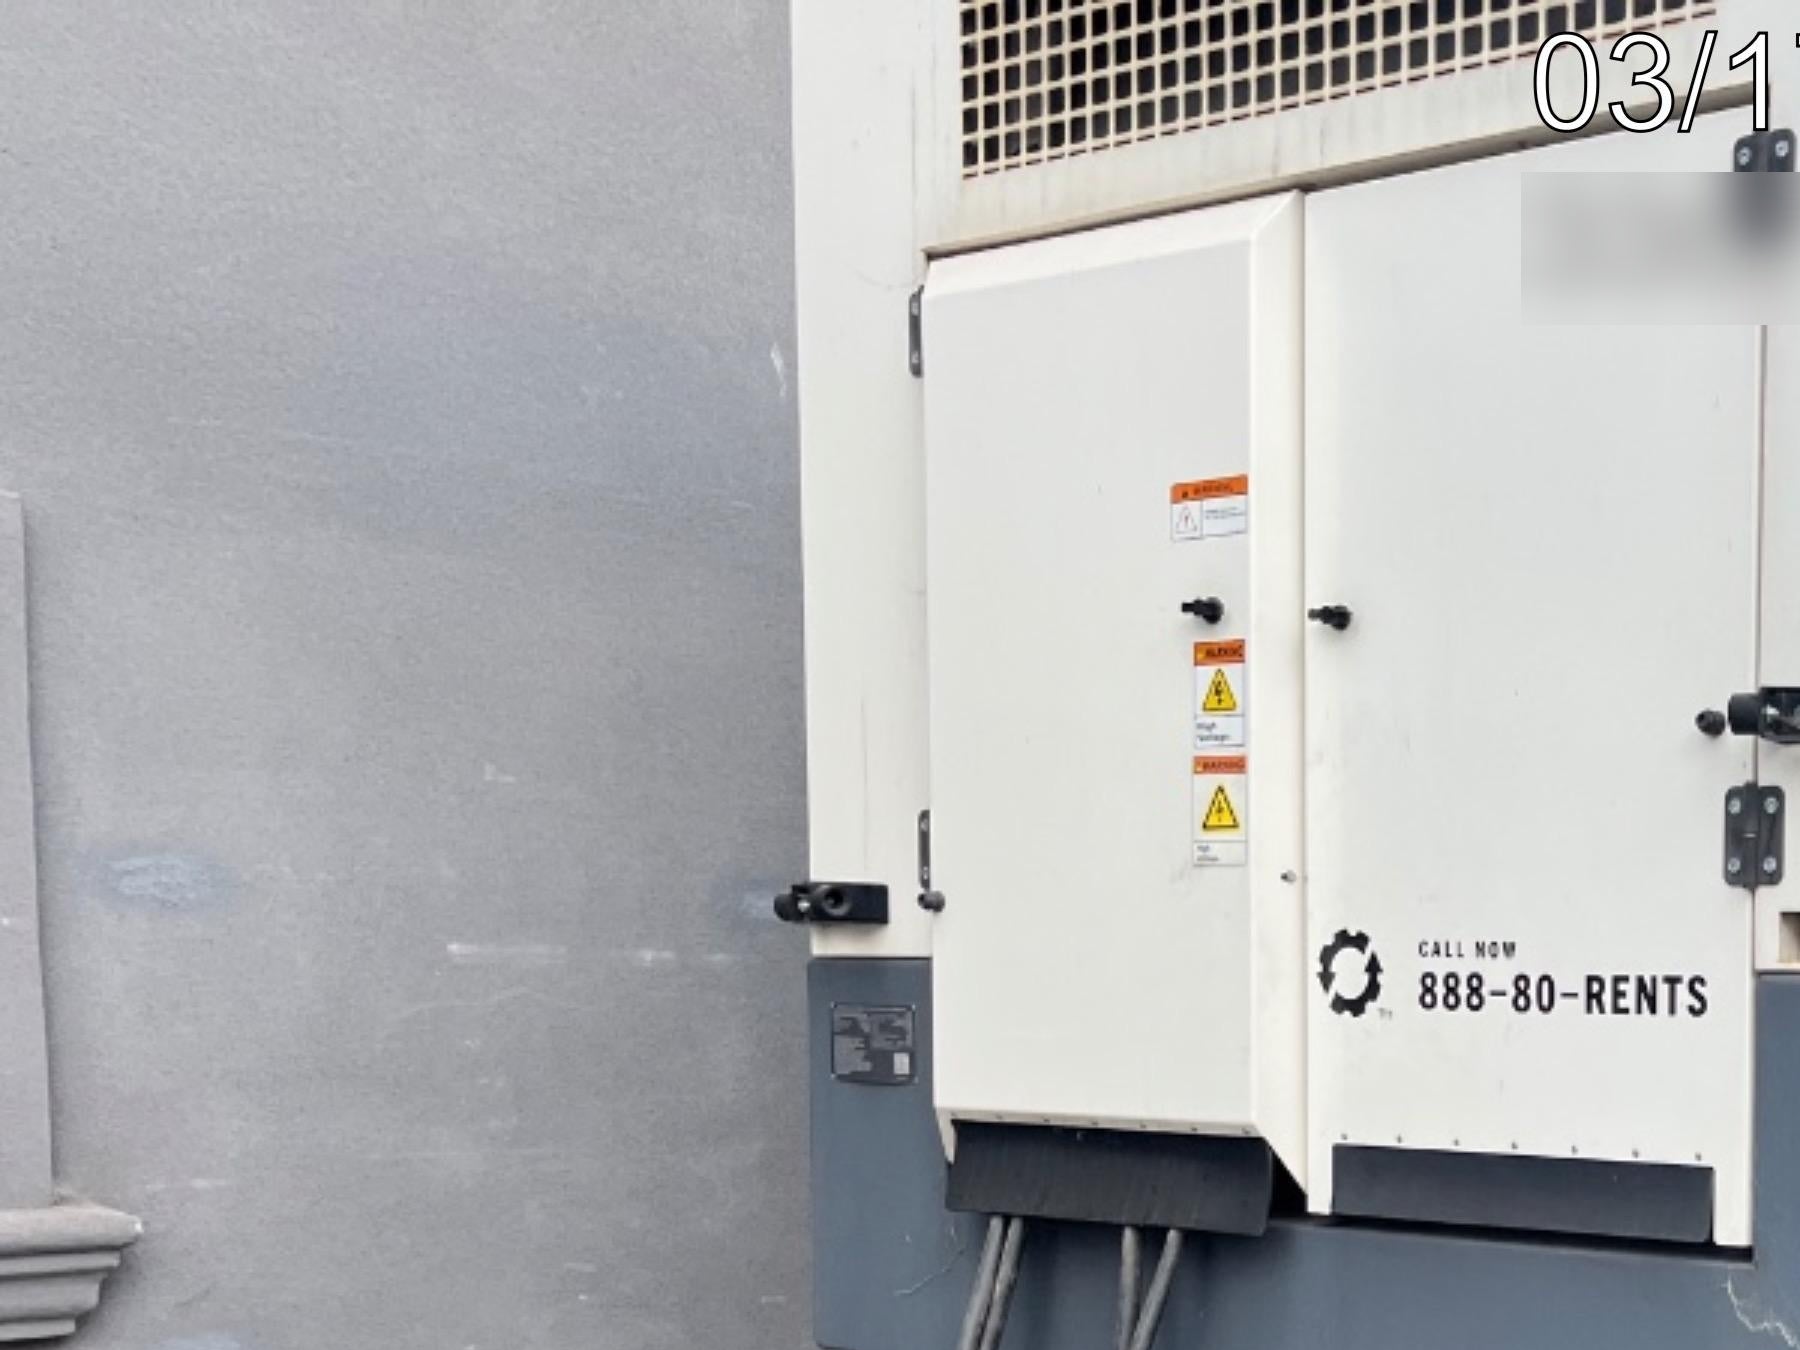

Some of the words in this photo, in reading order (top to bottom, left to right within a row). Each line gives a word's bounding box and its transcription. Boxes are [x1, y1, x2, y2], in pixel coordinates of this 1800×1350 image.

[1418, 941, 1464, 958] CALL
[1475, 941, 1517, 960] NOW
[1418, 971, 1710, 1018] 888-80-RENTS
